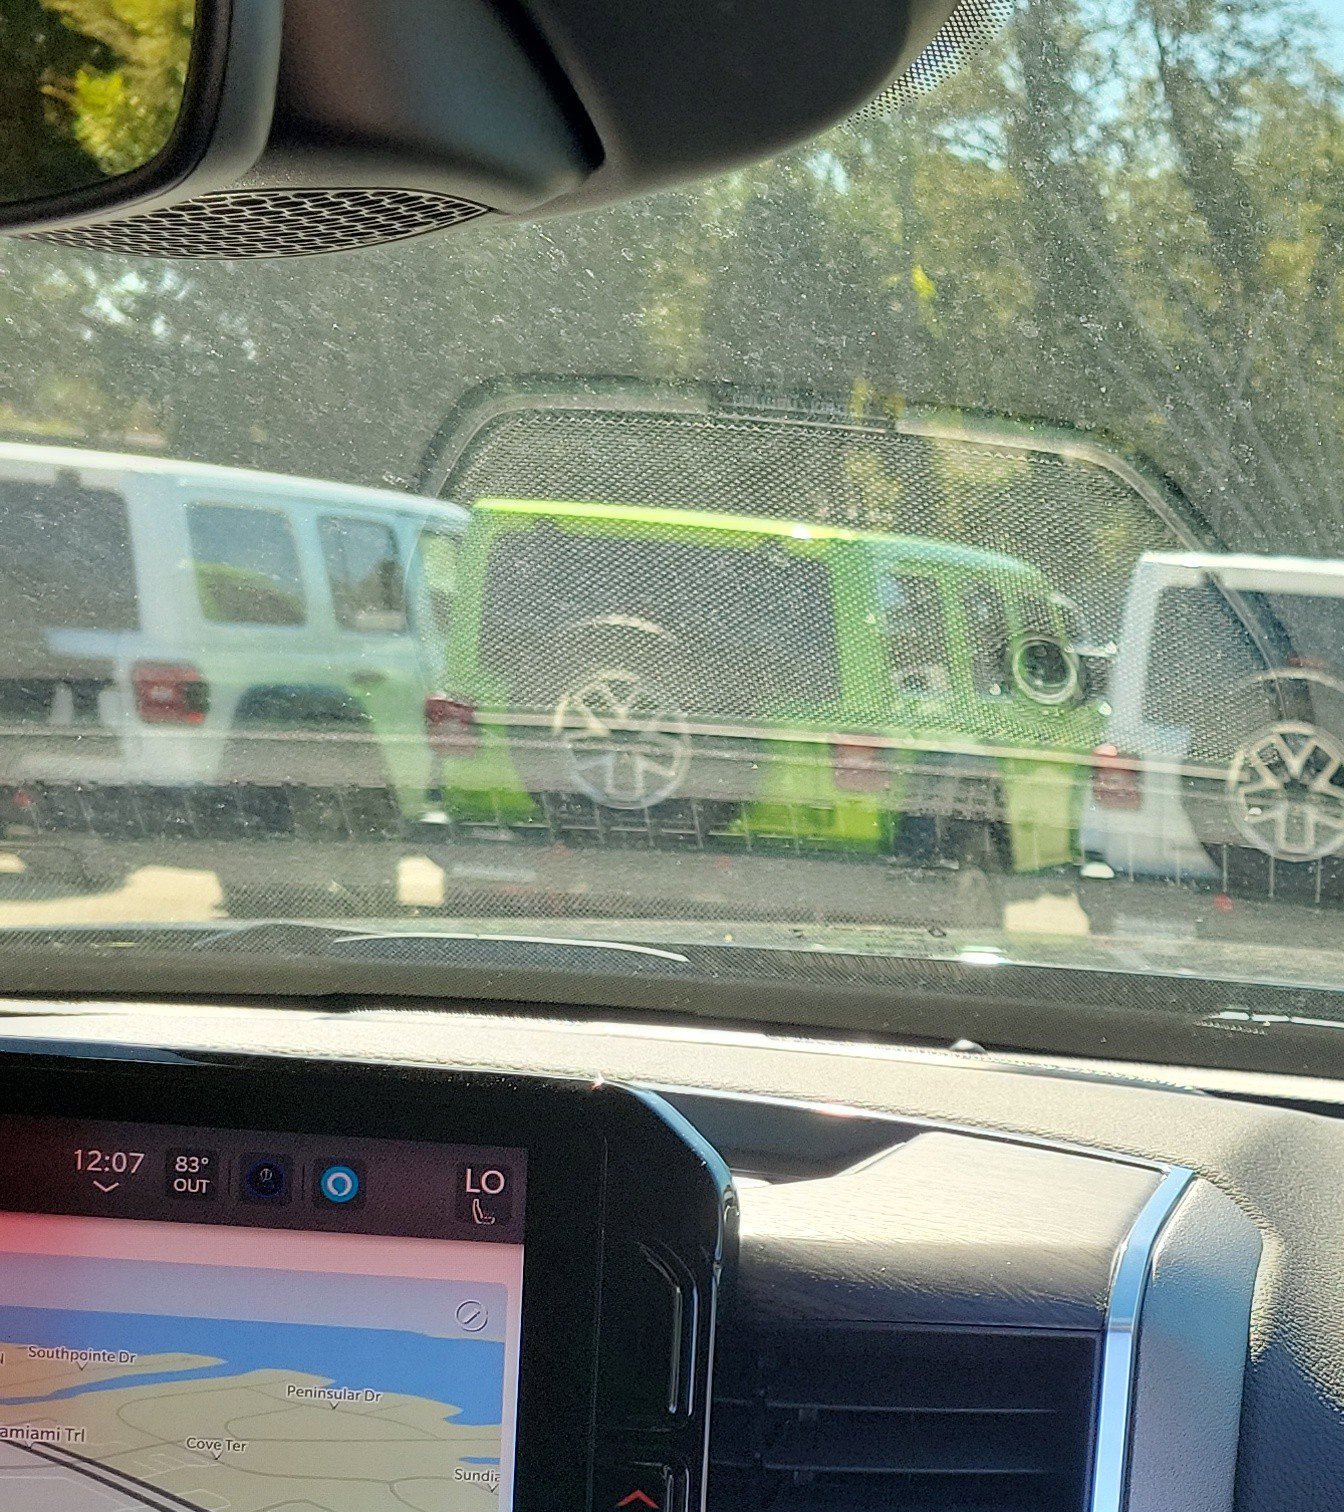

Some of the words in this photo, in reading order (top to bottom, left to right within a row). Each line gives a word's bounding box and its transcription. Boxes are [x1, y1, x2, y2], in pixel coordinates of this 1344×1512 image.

[74, 1149, 145, 1174] 12:07
[174, 1156, 209, 1173] 83°
[173, 1178, 210, 1194] OUT
[465, 1168, 505, 1194] LO
[28, 1345, 115, 1364] Southpointe
[119, 1351, 135, 1364] Dr
[286, 1385, 361, 1400] Peninsular
[365, 1389, 381, 1402] Dr
[0, 1425, 60, 1442] amiami
[65, 1428, 85, 1442] Trl
[186, 1437, 222, 1451] Cove
[225, 1439, 246, 1452] Ter
